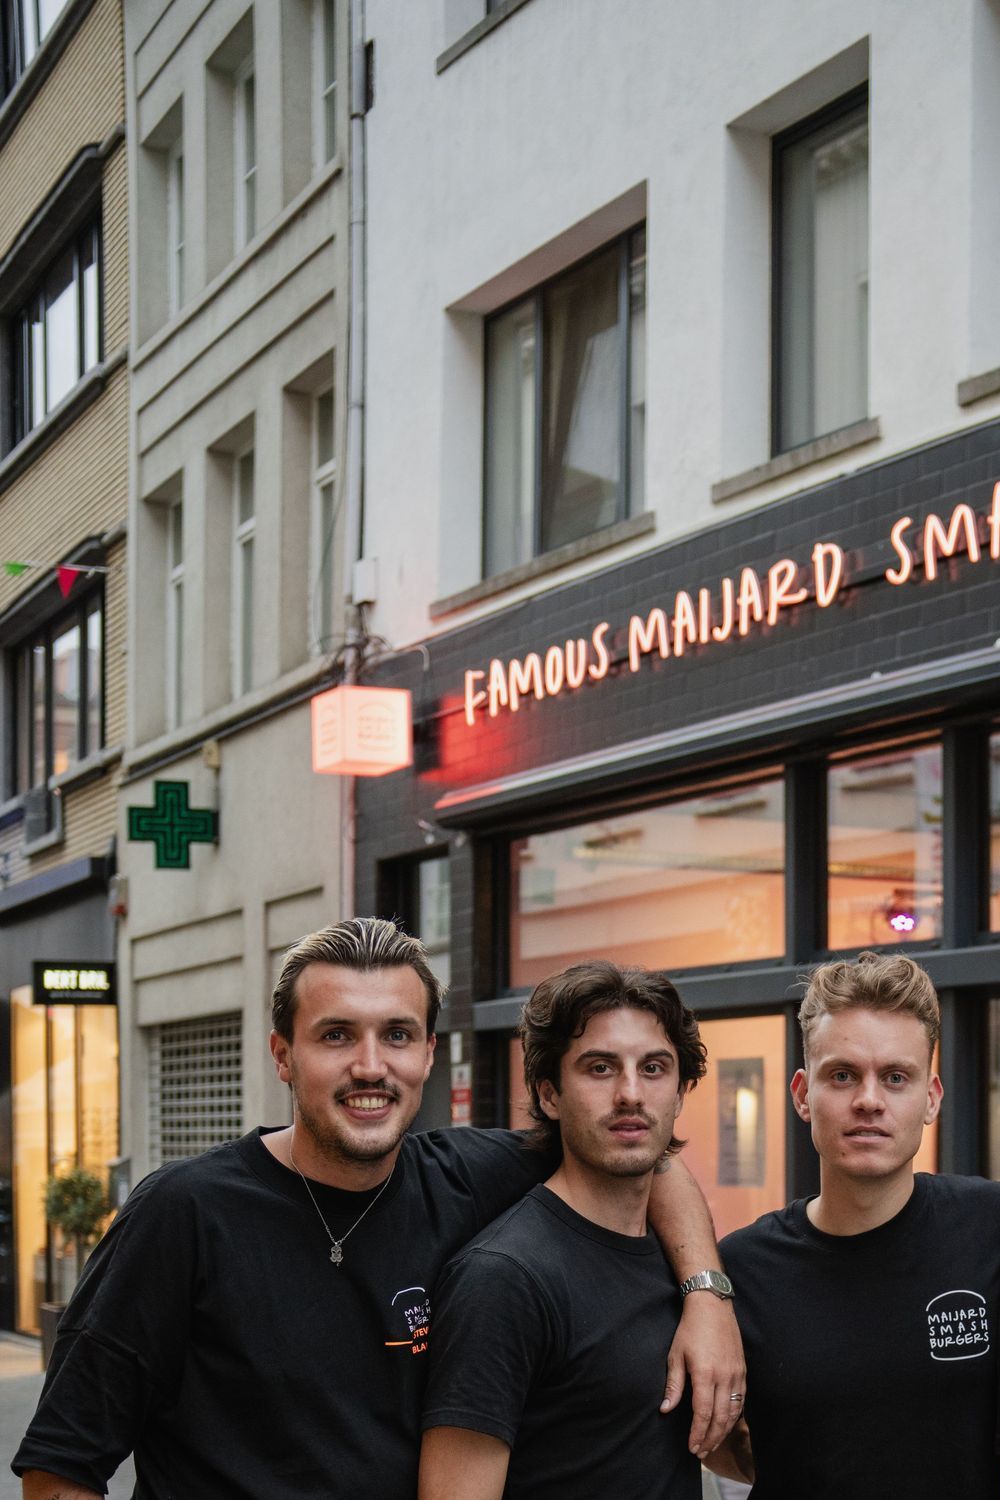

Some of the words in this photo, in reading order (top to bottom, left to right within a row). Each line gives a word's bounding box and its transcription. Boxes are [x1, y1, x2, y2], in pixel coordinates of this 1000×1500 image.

[464, 622, 610, 726] FAMOUS
[628, 541, 845, 673] MAIJARD
[927, 1307, 986, 1325] MAIJARD
[929, 1319, 988, 1336] SMASH
[412, 1342, 428, 1354] BLA
[929, 1331, 989, 1349] BURGERS
